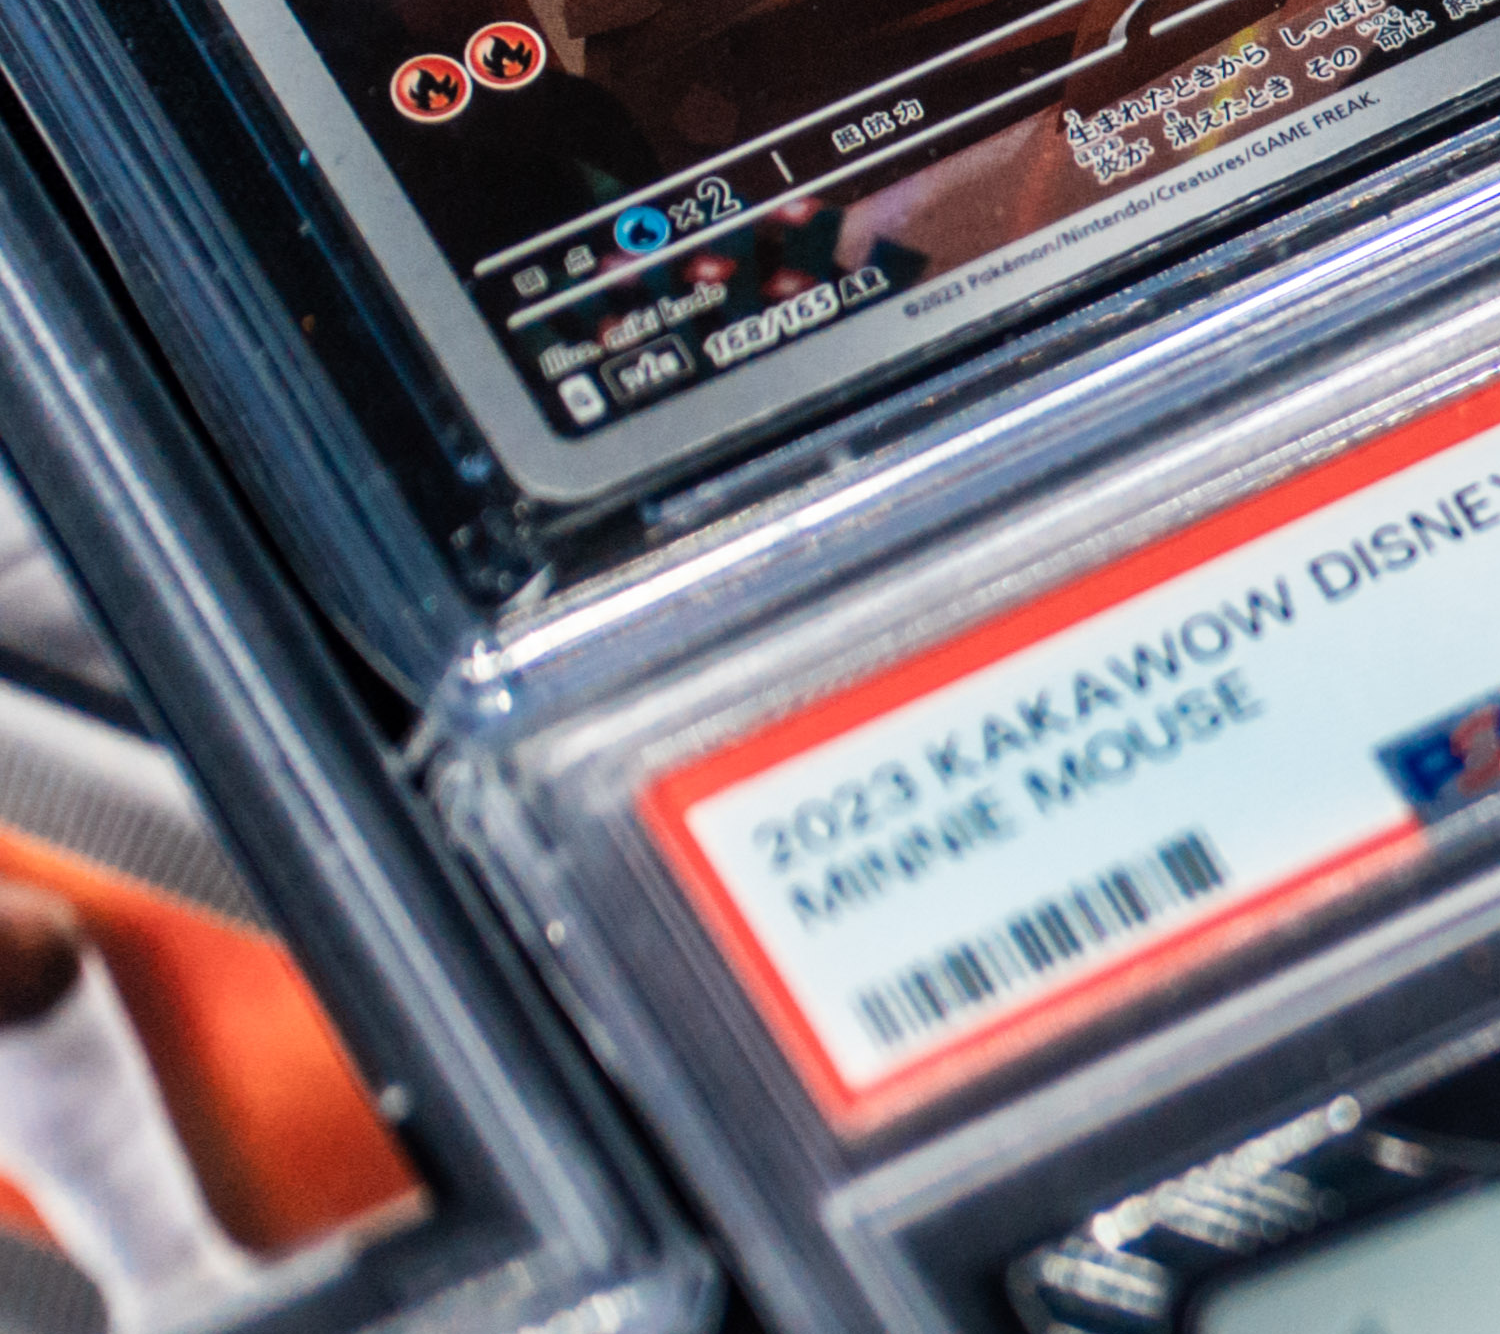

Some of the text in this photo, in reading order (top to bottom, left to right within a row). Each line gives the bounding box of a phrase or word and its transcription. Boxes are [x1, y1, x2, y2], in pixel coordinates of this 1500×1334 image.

[831, 97, 925, 155] 抵抗力
[1066, 42, 1270, 148] 生まれたときから
[1163, 75, 1294, 149] 消えたとき
[1306, 45, 1362, 81] その
[1372, 9, 1436, 52] 命は
[1311, 91, 1382, 130] FREAK.
[704, 282, 839, 367] 168/165
[753, 760, 920, 873] 2023
[923, 573, 1299, 789] KAKAWOW
[788, 666, 1267, 933] MINNIE MOUSE
